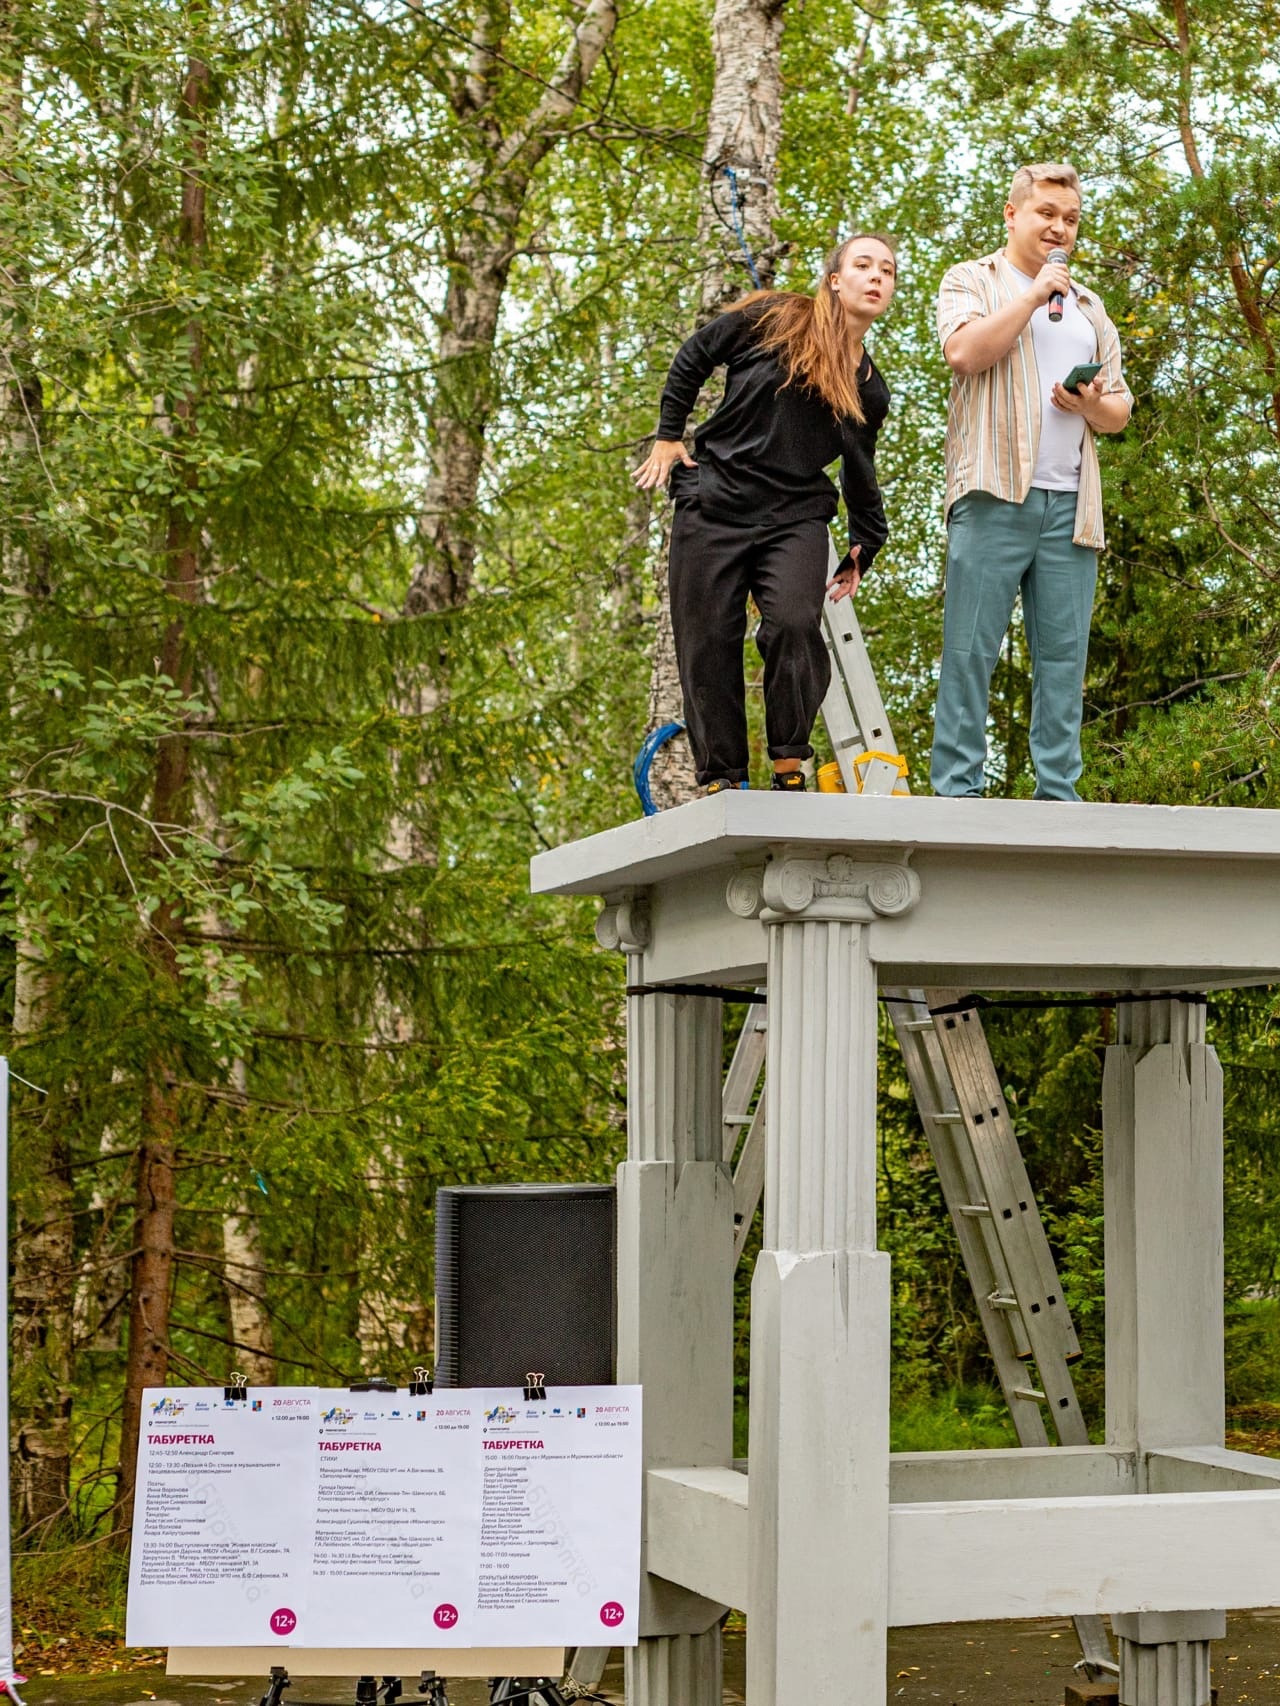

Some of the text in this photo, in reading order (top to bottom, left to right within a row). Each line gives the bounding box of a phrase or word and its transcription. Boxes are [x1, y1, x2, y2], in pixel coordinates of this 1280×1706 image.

[147, 1435, 215, 1444] ТАБУРЕТКА
[318, 1442, 382, 1450] ТАБУРЕТКА
[482, 1441, 544, 1449] ТАБУРЕТКА
[437, 1610, 456, 1621] 12+
[604, 1608, 622, 1619] 12+
[275, 1615, 295, 1627] 12+
